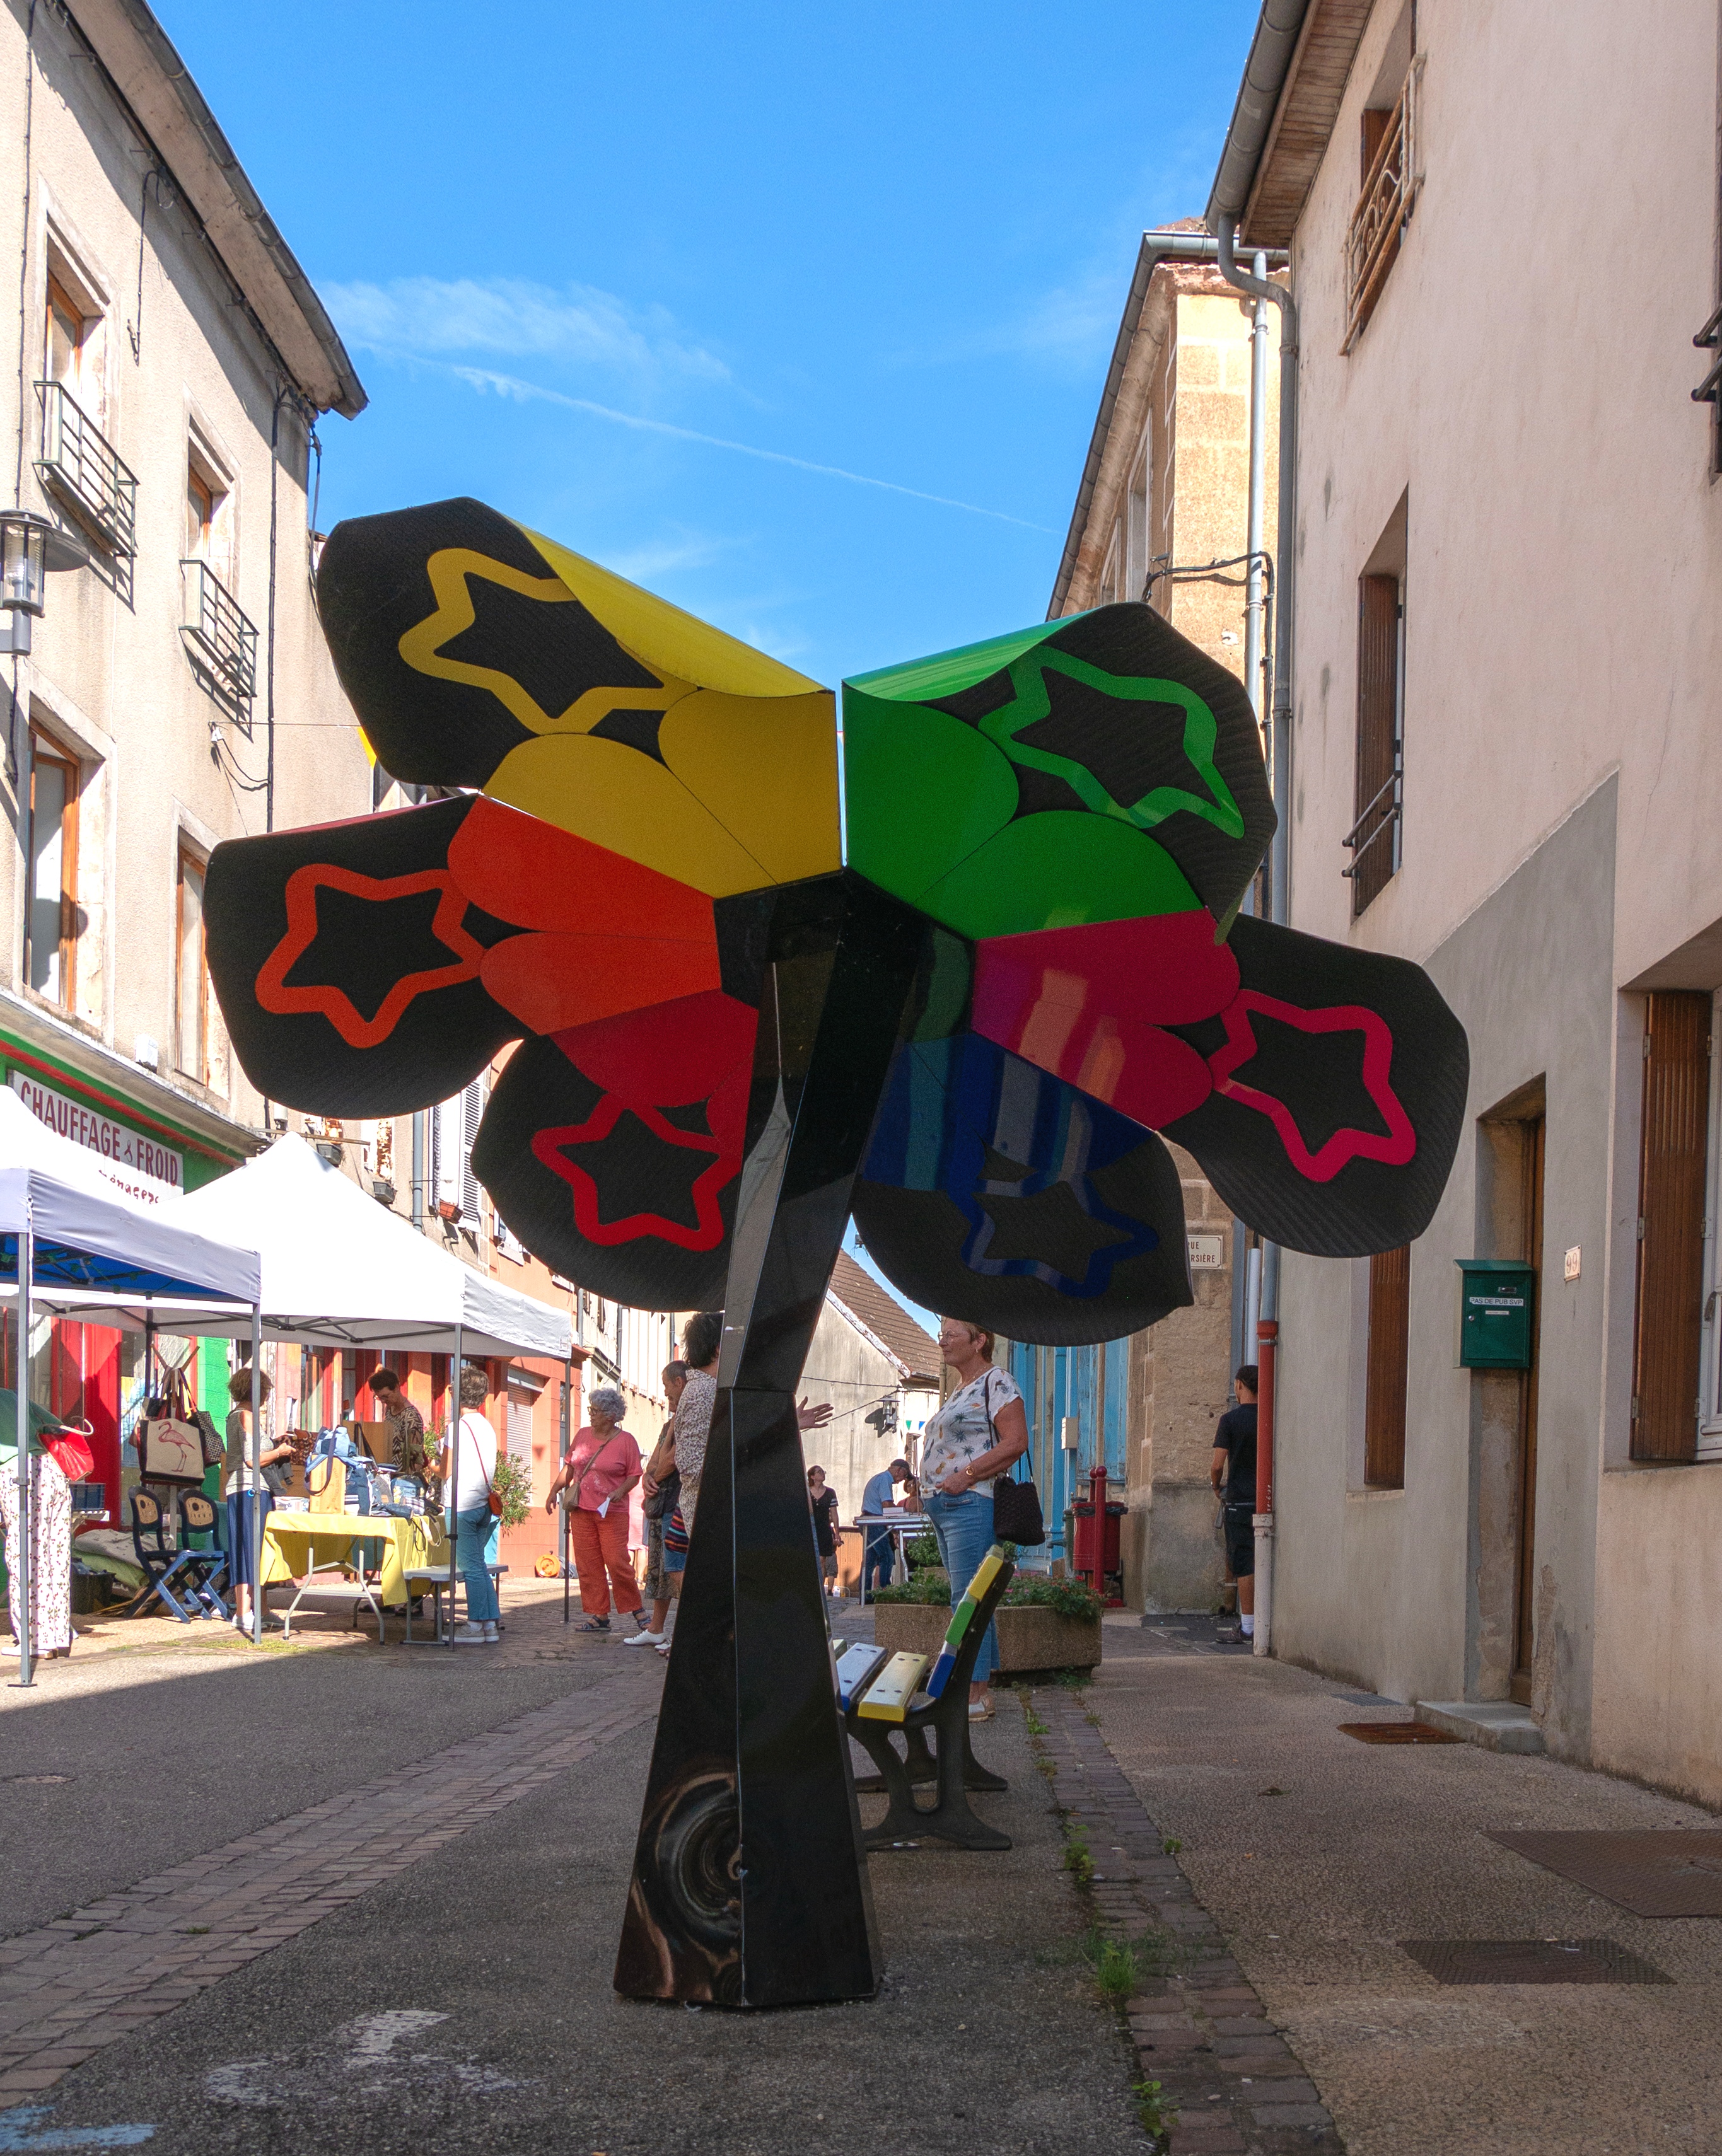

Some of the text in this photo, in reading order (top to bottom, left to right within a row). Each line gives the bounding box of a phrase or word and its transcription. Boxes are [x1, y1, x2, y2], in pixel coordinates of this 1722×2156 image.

[21, 1081, 120, 1162] CHAUFFAGE
[137, 1138, 178, 1186] FROID
[1191, 1253, 1215, 1263] RSIÈRE
[1566, 1253, 1577, 1274] 99
